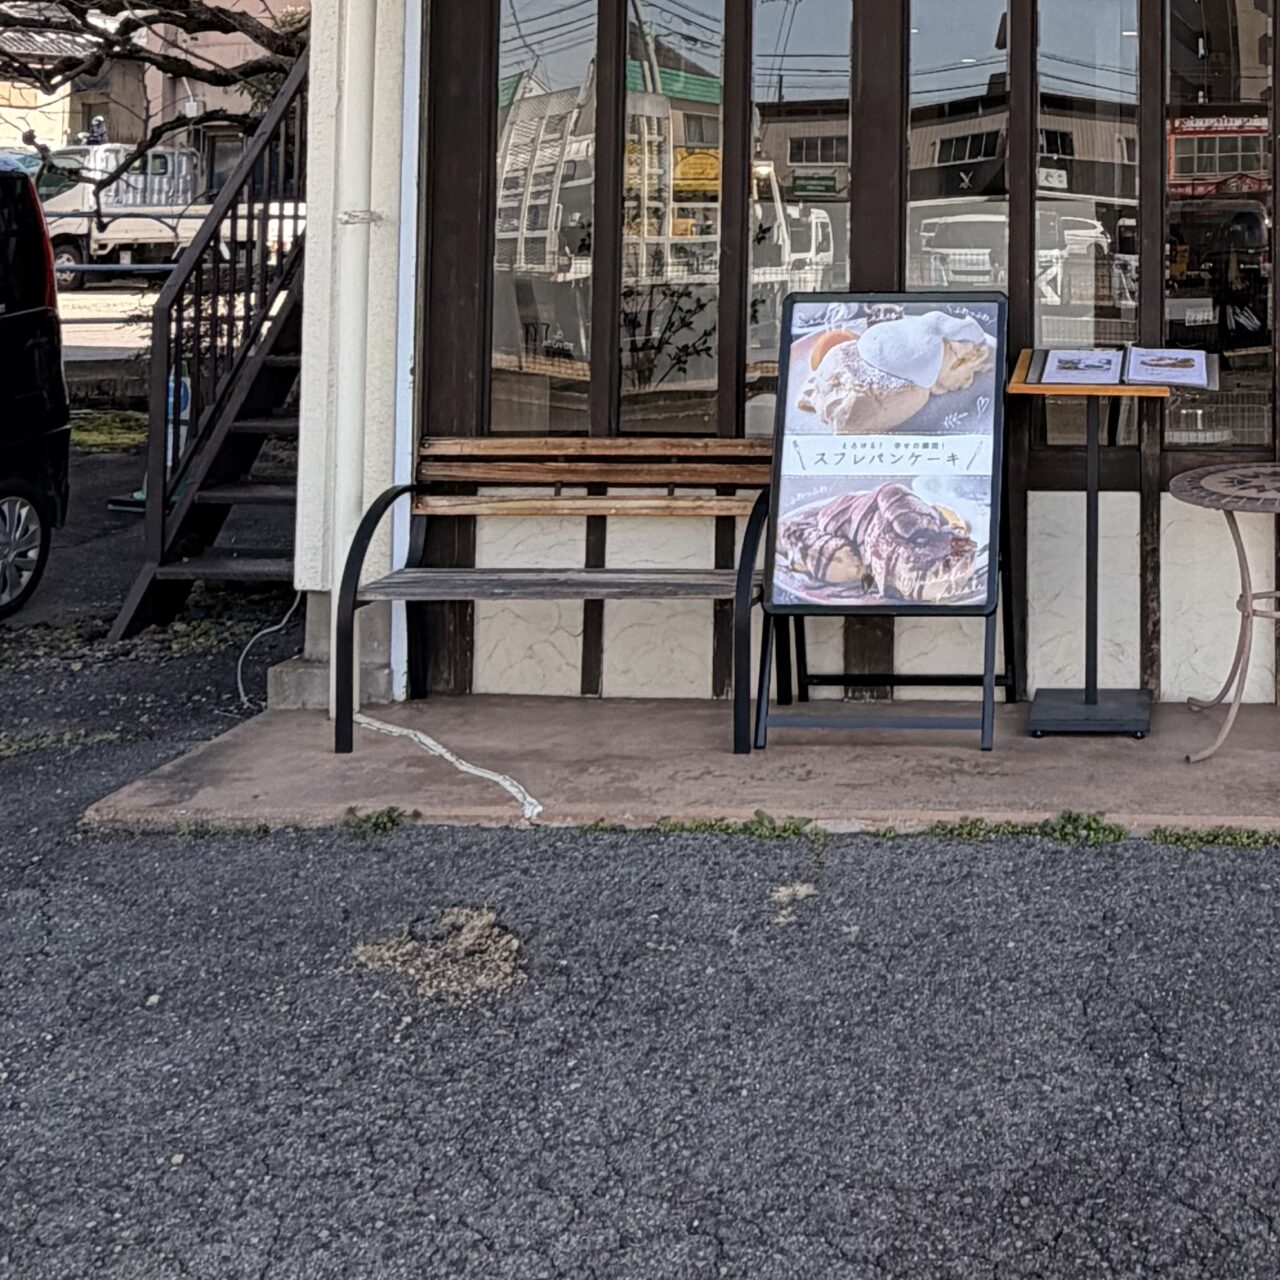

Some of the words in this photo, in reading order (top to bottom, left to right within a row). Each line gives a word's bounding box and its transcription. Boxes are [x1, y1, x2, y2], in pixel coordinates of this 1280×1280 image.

[813, 451, 961, 467] スフレパンケーキ
